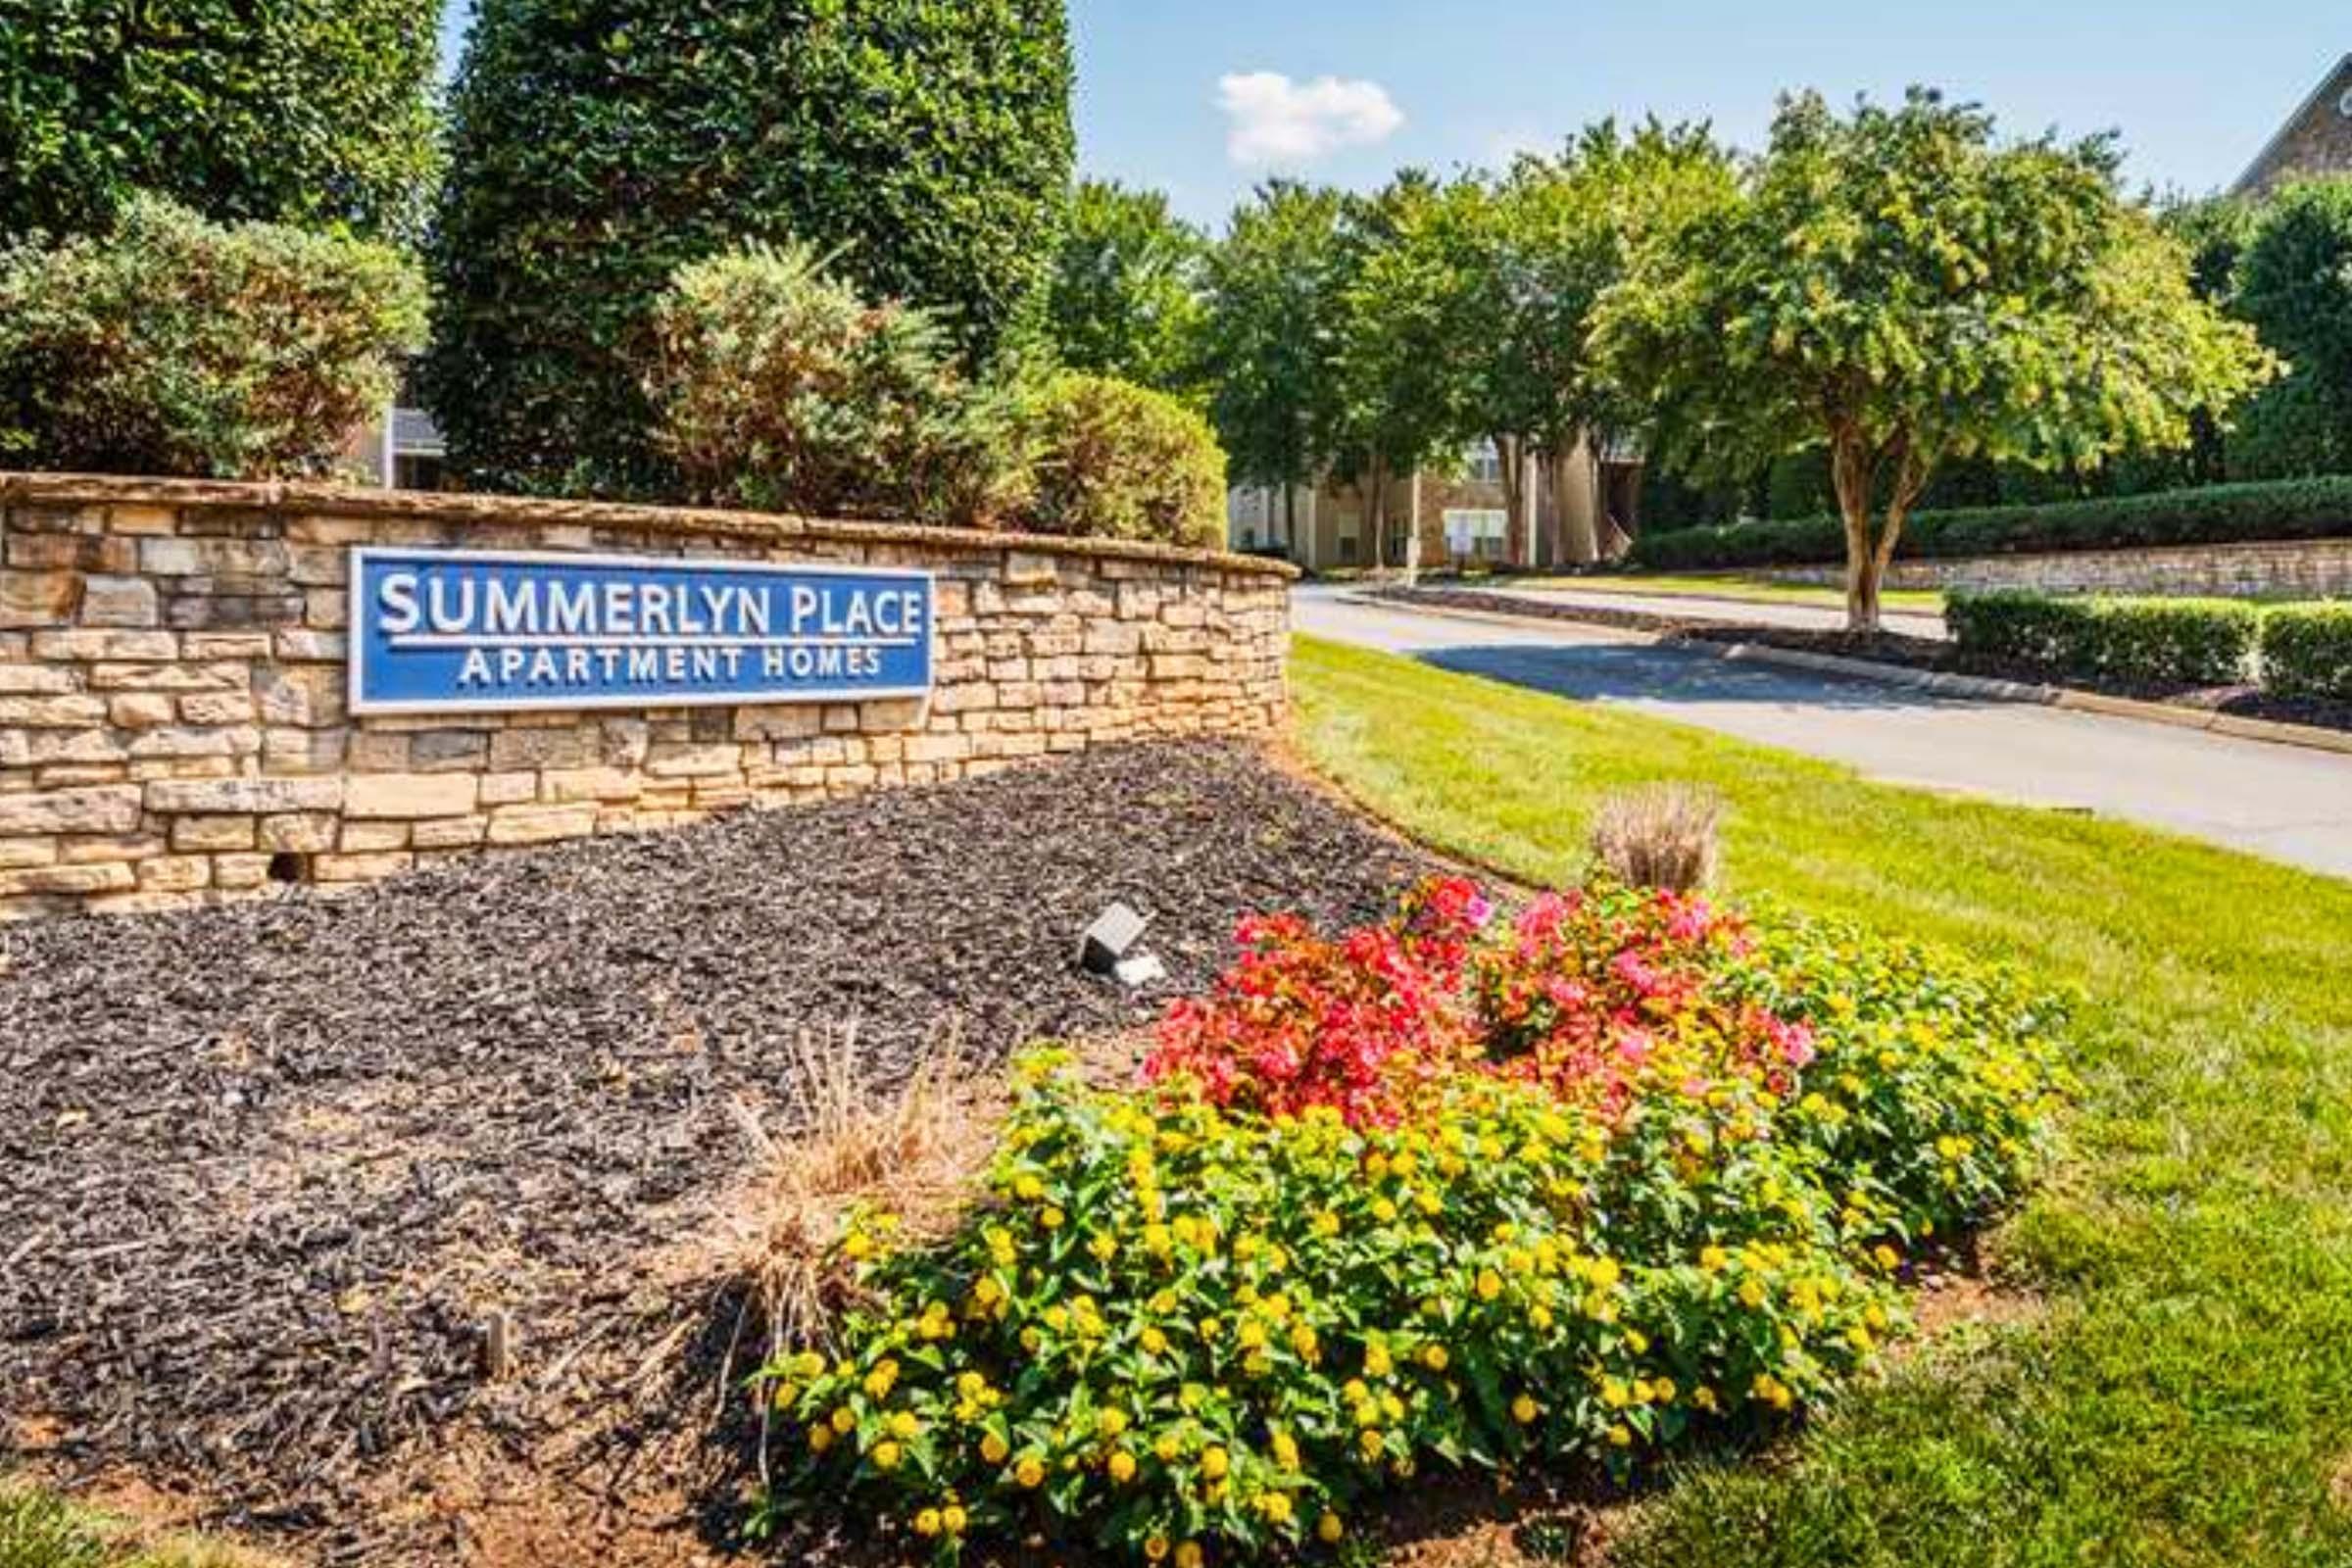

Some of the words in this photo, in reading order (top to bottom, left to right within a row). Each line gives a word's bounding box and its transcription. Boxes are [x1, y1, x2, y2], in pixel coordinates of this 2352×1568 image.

[377, 572, 770, 634] SUMMERLYN
[791, 586, 922, 635] PLACE
[461, 647, 743, 684] APARTMENT
[763, 647, 880, 677] HOMES
